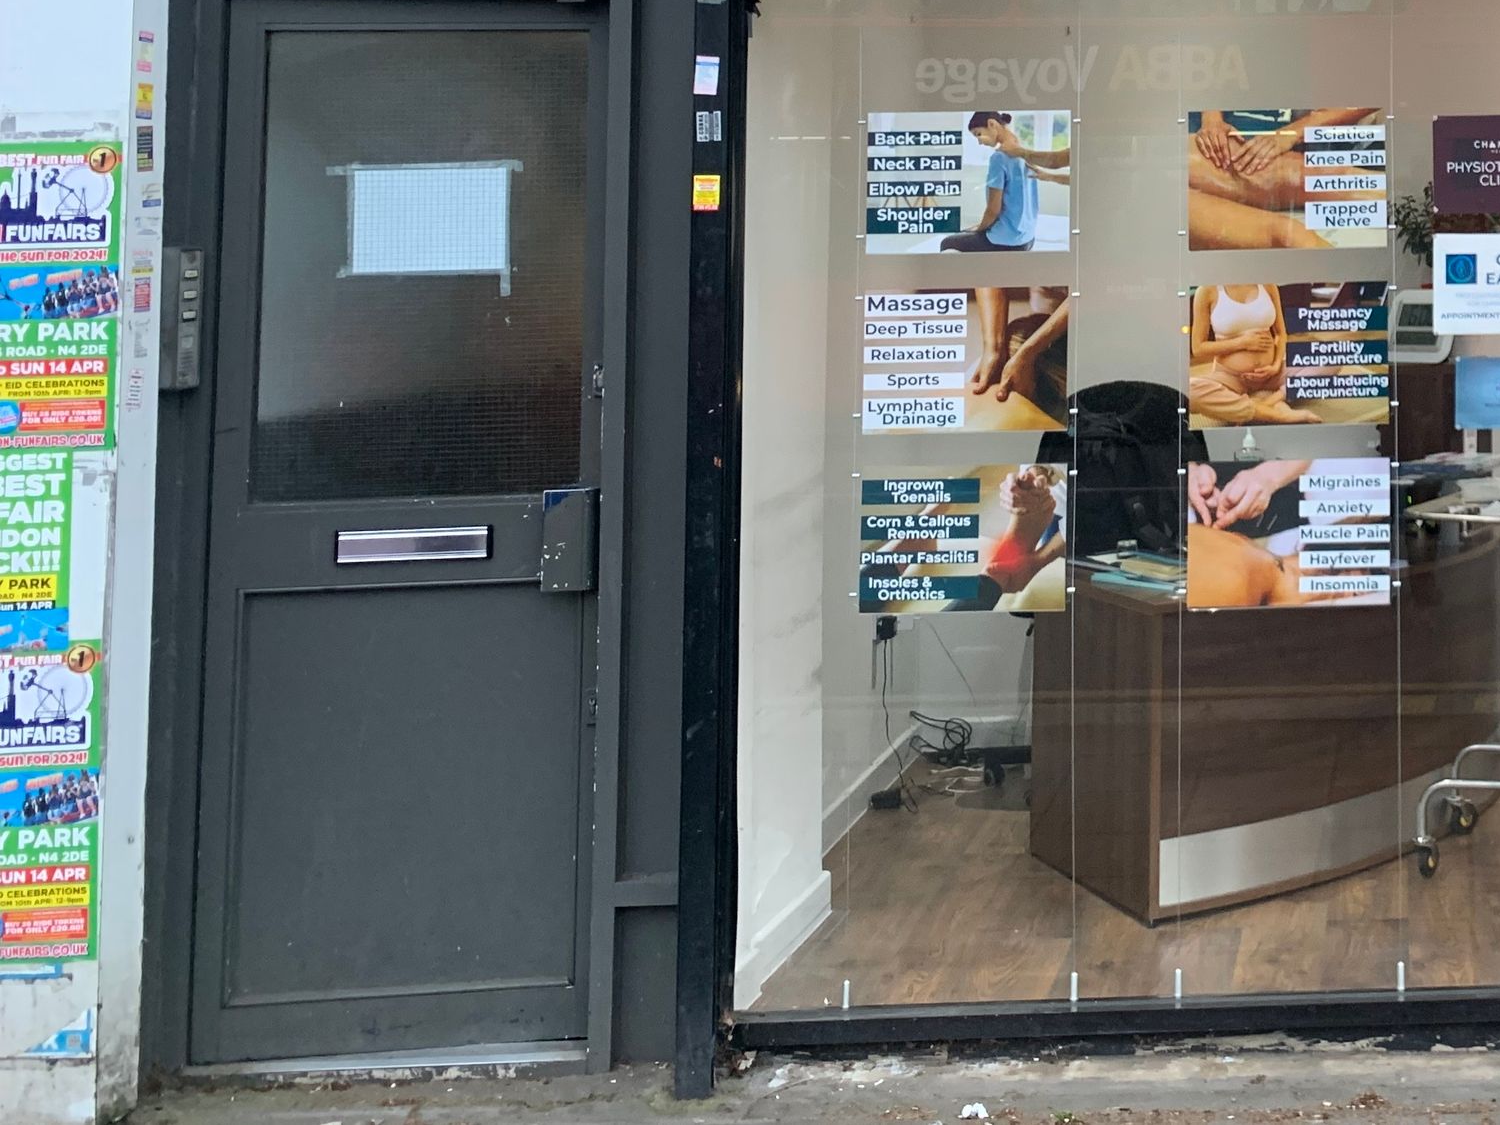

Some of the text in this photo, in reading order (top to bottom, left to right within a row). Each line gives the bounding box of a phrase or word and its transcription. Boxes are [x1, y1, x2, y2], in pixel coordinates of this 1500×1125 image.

[874, 131, 956, 146] Back Pain
[873, 156, 956, 170] Neck Pain
[1306, 152, 1384, 166] Knee Pain
[869, 181, 960, 196] Elbow Pain
[1313, 178, 1378, 190] Arthritis
[876, 207, 951, 222] Shoulder
[1313, 202, 1378, 218] Trapped
[898, 221, 934, 234] Pain
[1325, 216, 1371, 227] Nerve
[6, 223, 101, 243] FUNFAIRS
[47, 249, 106, 261] FOR 2024!
[867, 295, 964, 315] Massage
[1298, 307, 1373, 322] Pregnancy
[37, 321, 109, 342] PARK
[865, 321, 964, 337] Deep Tissue
[1307, 319, 1367, 332] Massage
[5, 344, 108, 358] ROAD N4 2DE
[871, 347, 957, 361] Relaxation
[1311, 341, 1364, 356] Fertility
[10, 360, 104, 375] SUN 14 APR
[1292, 354, 1383, 367] Acupuncture
[5, 378, 105, 390] EID CELEBRATIONS
[887, 374, 940, 388] Sports
[1286, 374, 1389, 389] Labour Inducing
[1296, 387, 1380, 400] Acupuncture
[868, 398, 954, 414] Lymphatic
[882, 413, 957, 426] Drainage
[884, 479, 944, 494] Ingrown
[1309, 476, 1381, 490] Migraines
[891, 491, 951, 503] Toenails
[1317, 502, 1374, 515] Anxiety
[866, 514, 971, 528] Corn & Callous
[887, 526, 950, 539] Removal
[1300, 527, 1389, 540] Muscle Pain
[861, 552, 913, 564] Plantar
[1309, 553, 1375, 568] Hayfever
[9, 578, 51, 590] PARK
[868, 576, 933, 589] Insoles &
[1310, 580, 1379, 591] Insomnia
[877, 588, 945, 601] Orthotics
[16, 600, 53, 610] 14 APR
[27, 752, 87, 764] FOR 2024!
[18, 826, 91, 849] PARK
[39, 850, 90, 863] N4 2DE
[30, 867, 87, 882] 14 APR
[6, 886, 88, 899] CELEBRATIONS
